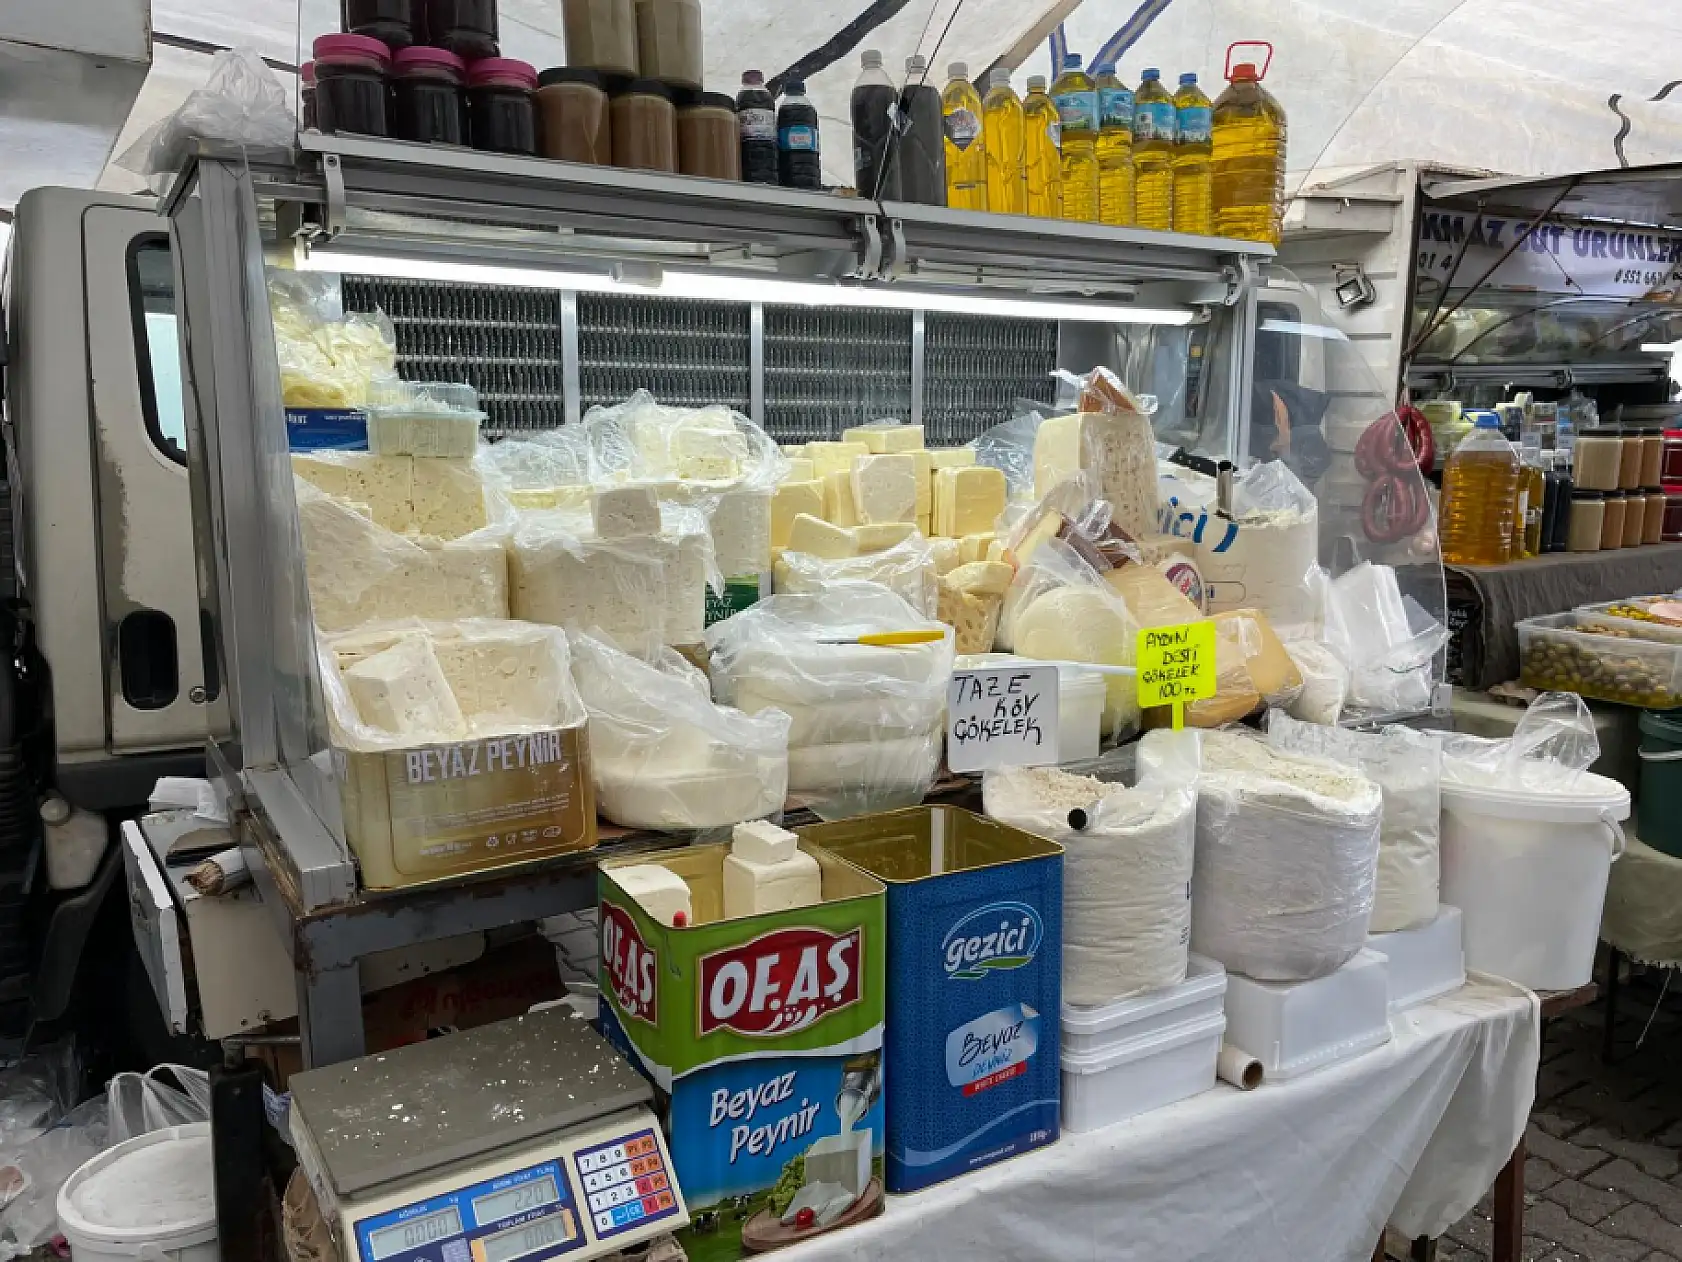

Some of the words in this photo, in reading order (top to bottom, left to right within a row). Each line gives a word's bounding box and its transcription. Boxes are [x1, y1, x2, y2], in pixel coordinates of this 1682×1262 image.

[954, 674, 1031, 704] TAZE
[1160, 682, 1182, 699] 100
[954, 715, 1043, 746] ÇÖKELEK
[406, 744, 481, 784] BEYAZ
[944, 917, 1030, 972] gezici
[710, 1070, 797, 1127] Beyaz
[730, 1097, 820, 1164] Peynir
